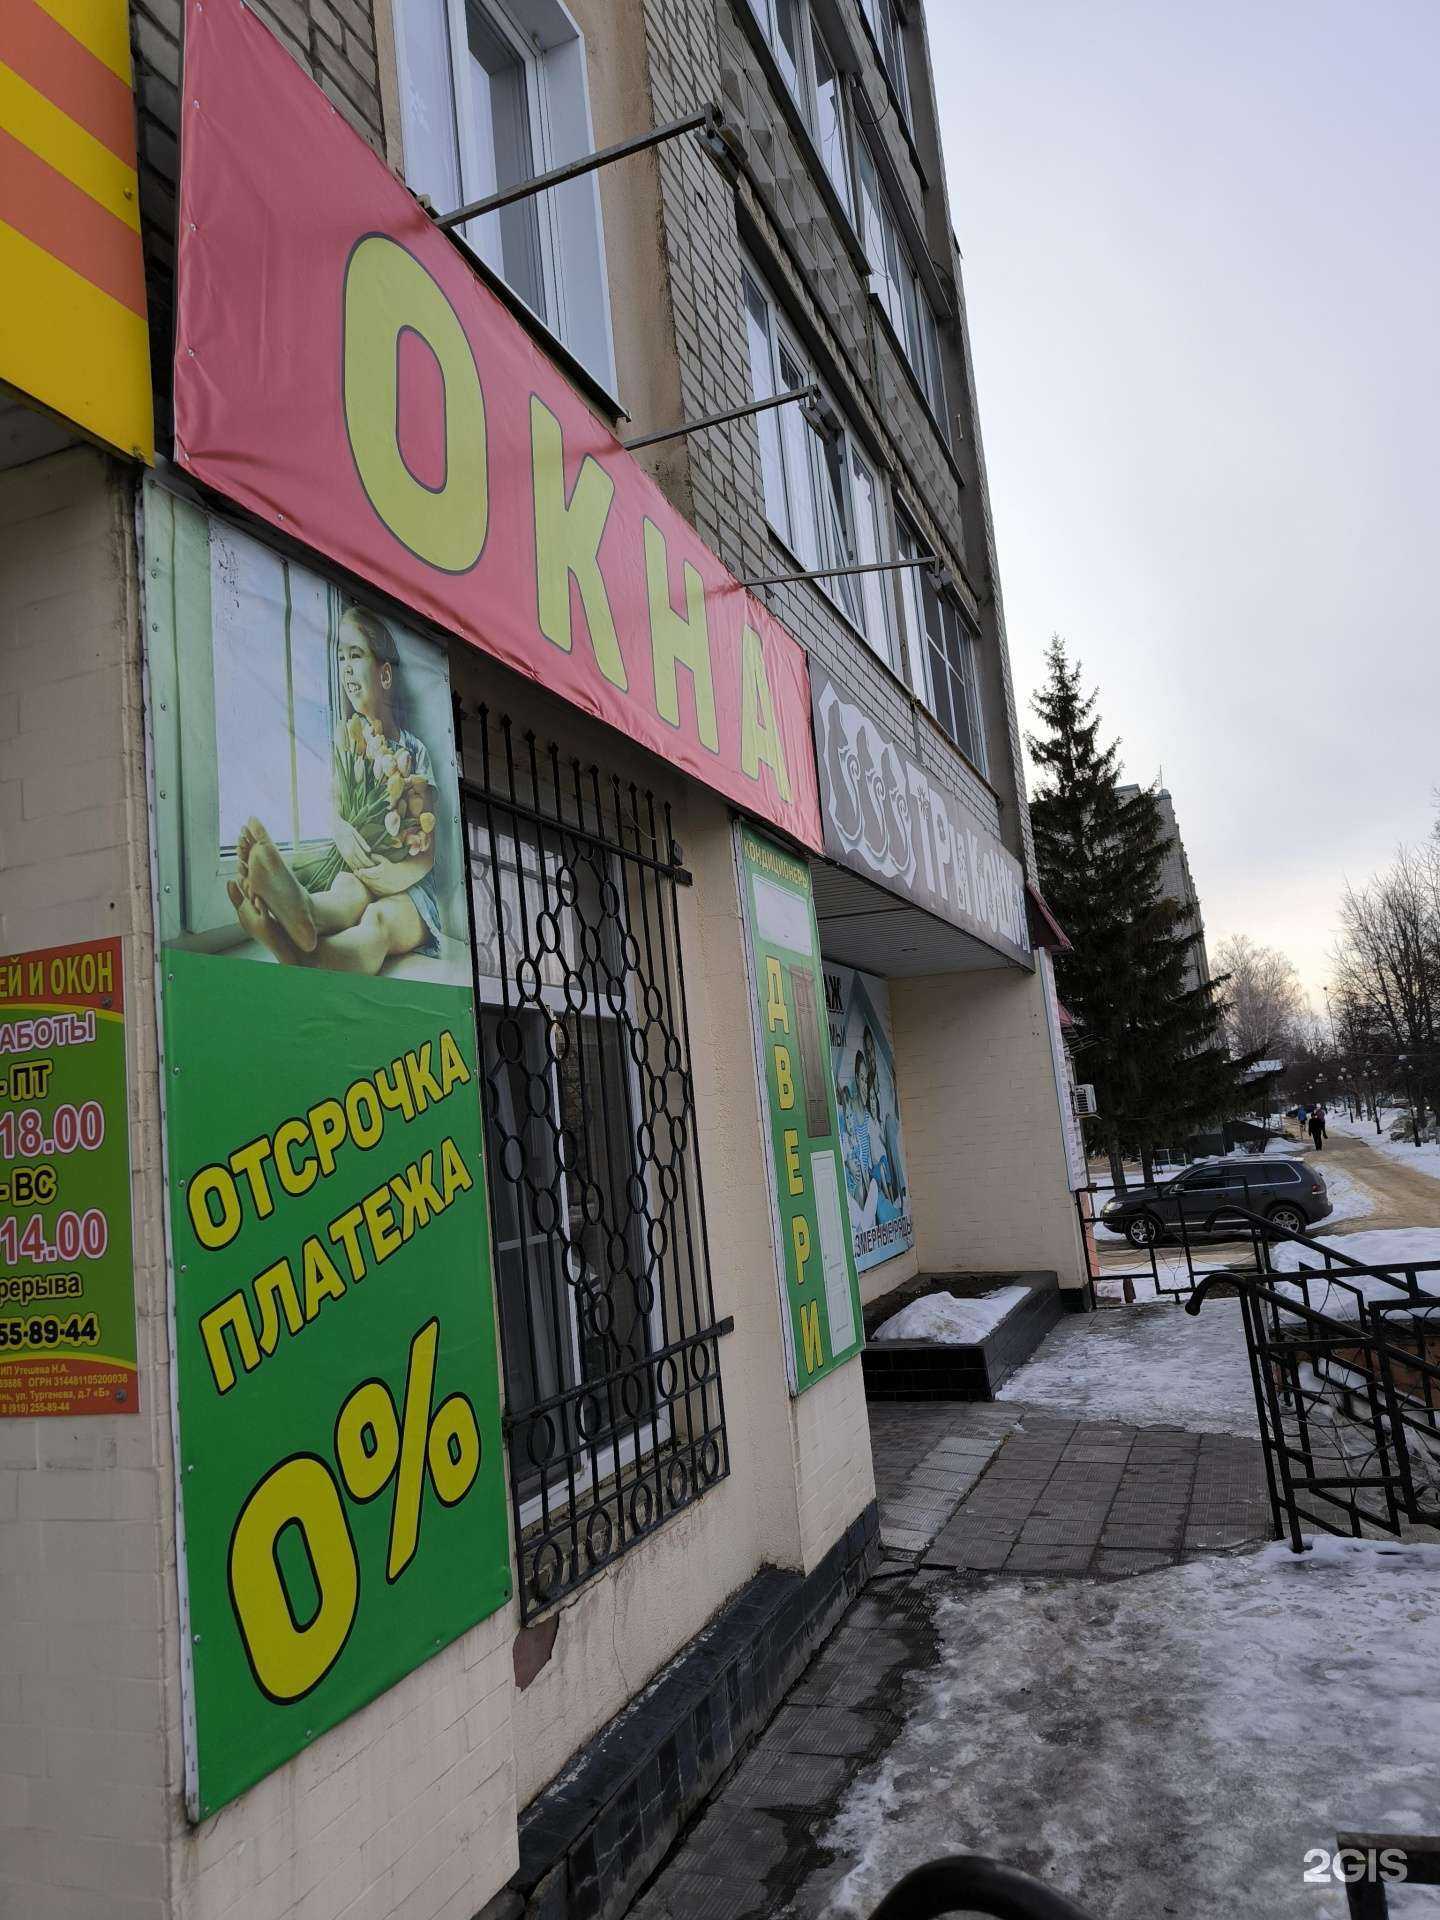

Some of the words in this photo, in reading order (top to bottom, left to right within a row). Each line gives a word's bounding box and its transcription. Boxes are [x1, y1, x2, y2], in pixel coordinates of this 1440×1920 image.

[341, 230, 793, 804] ОКНА
[29, 961, 44, 996] И
[50, 950, 113, 994] ОКОН
[186, 1030, 472, 1252] ОТСРОЧКА
[199, 1136, 474, 1396] ПЛАТЕЖА
[766, 955, 825, 1376] ДВЕРИ
[28, 1376, 53, 1388] ОГРН
[227, 1317, 481, 1706] 0%
